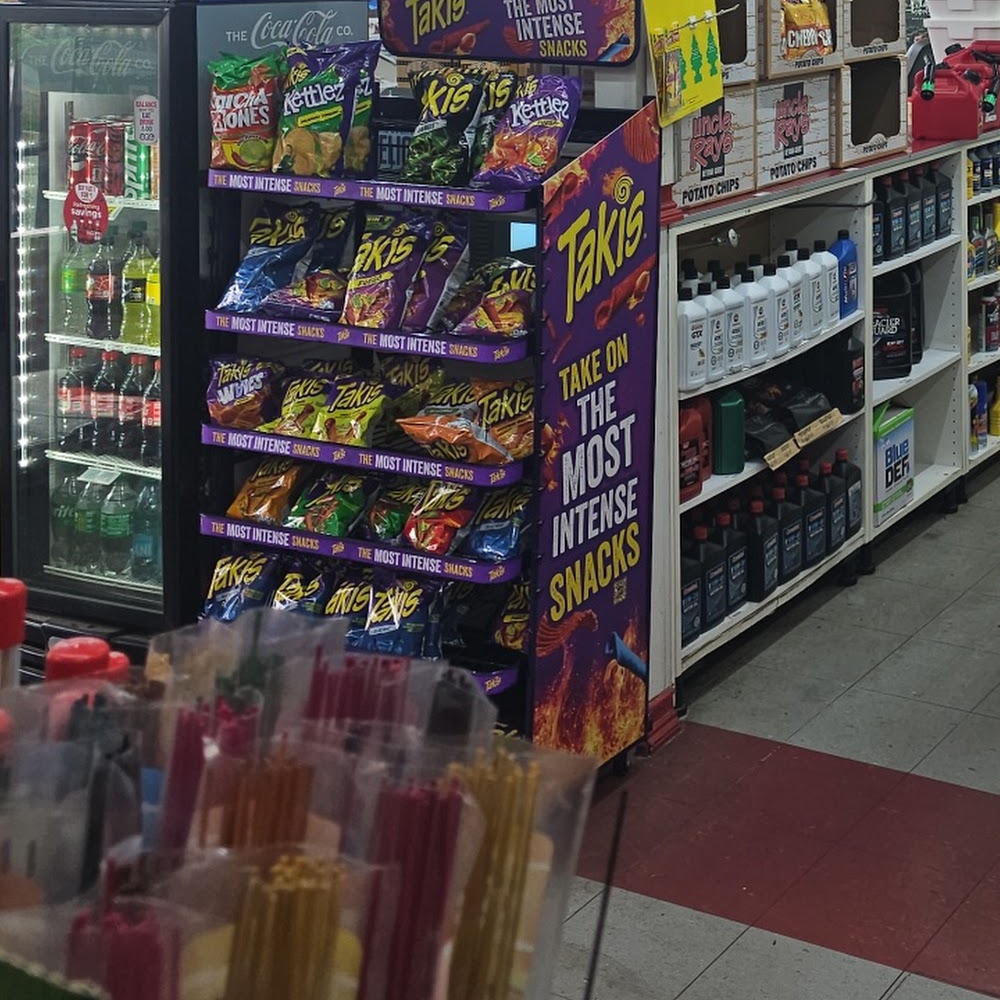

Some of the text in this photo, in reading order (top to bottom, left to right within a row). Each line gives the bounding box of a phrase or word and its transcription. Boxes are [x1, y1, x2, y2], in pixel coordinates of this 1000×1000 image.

[226, 30, 248, 42] THE
[336, 26, 353, 37] CO.
[515, 12, 585, 41] INTENSE
[539, 39, 588, 58] SNACKS
[283, 82, 346, 117] Kettlez
[510, 95, 571, 129] Kettlez
[770, 157, 817, 181] POTATO CHIPS
[214, 174, 321, 195] THE MOST INTENSE SNACKS
[360, 185, 475, 206] THE MOST INTENSE SNACKS
[682, 178, 740, 205] POTATO CHIPS
[71, 207, 102, 219] savings
[556, 174, 646, 325] Takis
[216, 315, 325, 339] THE MOST INTENSE SNACKS
[363, 332, 478, 358] THE MOST INTENSE SNACKS
[557, 333, 629, 402] TAKE ON
[576, 380, 618, 437] THE
[228, 432, 321, 458] MOST INTENSE SNACKS
[885, 438, 910, 468] Blue
[375, 454, 474, 481] MOST INTENSE SNACKS
[562, 414, 636, 505] MOST
[552, 477, 640, 560] INTENSE
[226, 523, 320, 550] MOST INTENSE SNACKS
[373, 548, 473, 578] MOST INTENSE SNACKS
[549, 521, 641, 624] SNACKS
